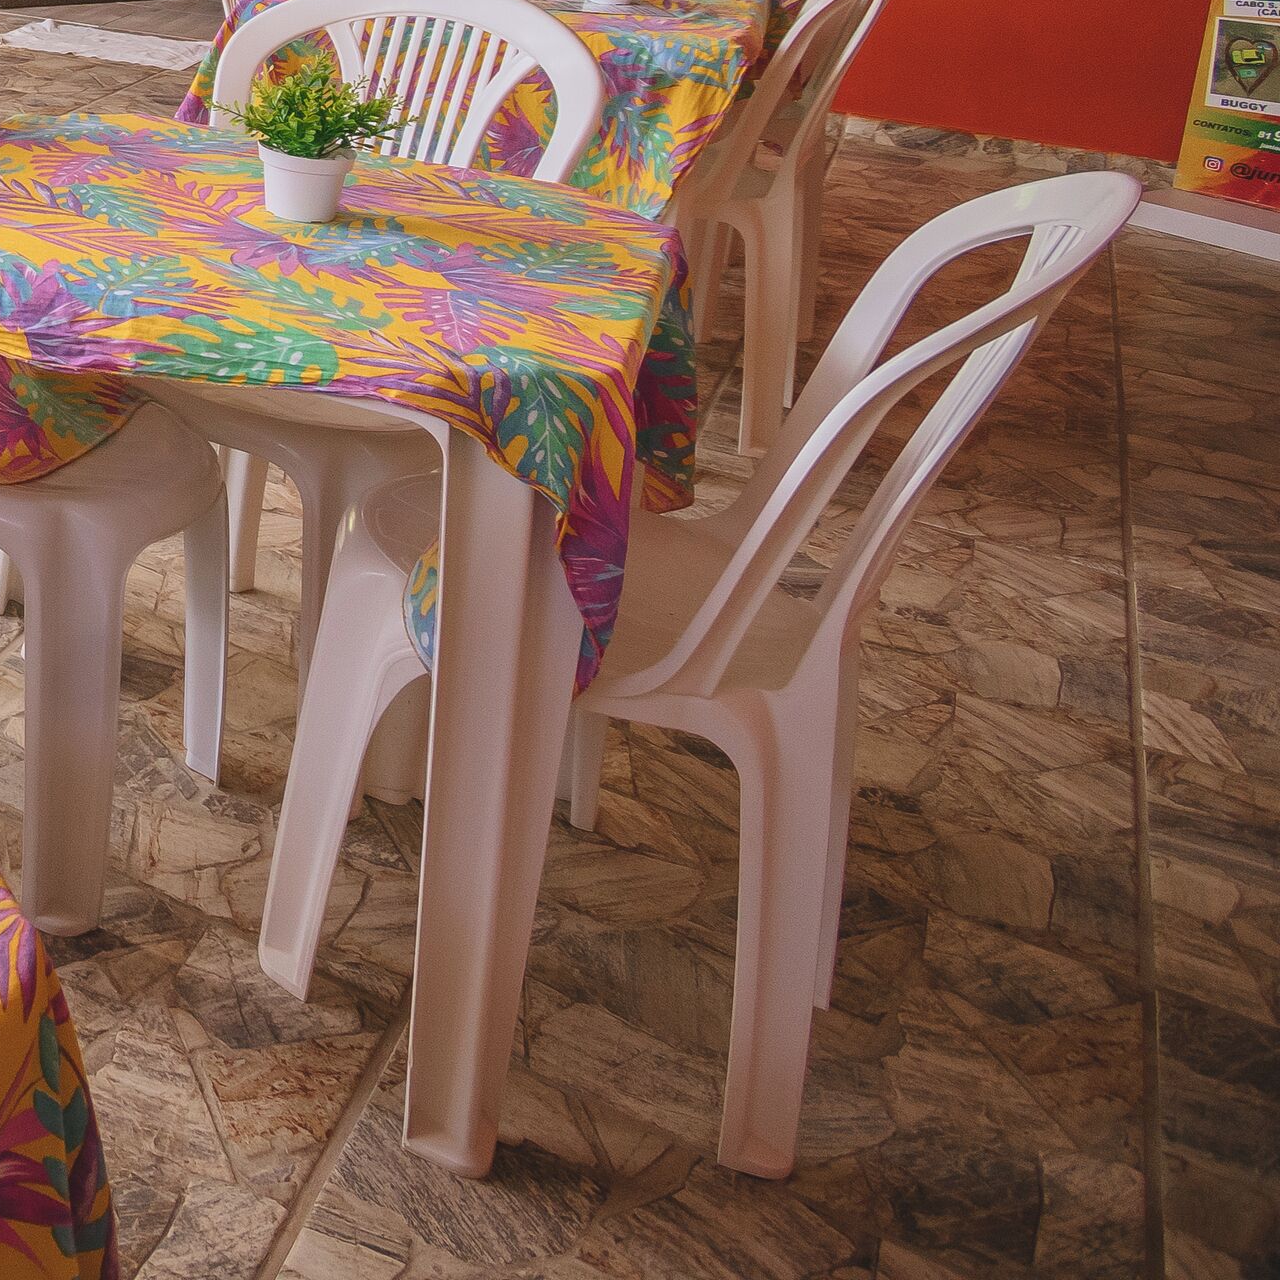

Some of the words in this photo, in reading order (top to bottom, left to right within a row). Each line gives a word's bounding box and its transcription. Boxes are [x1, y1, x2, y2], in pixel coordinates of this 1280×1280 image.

[1235, 0, 1265, 8] CABO
[1257, 9, 1280, 17] (CA
[1220, 98, 1268, 112] BUGGY
[1257, 131, 1272, 140] 81
